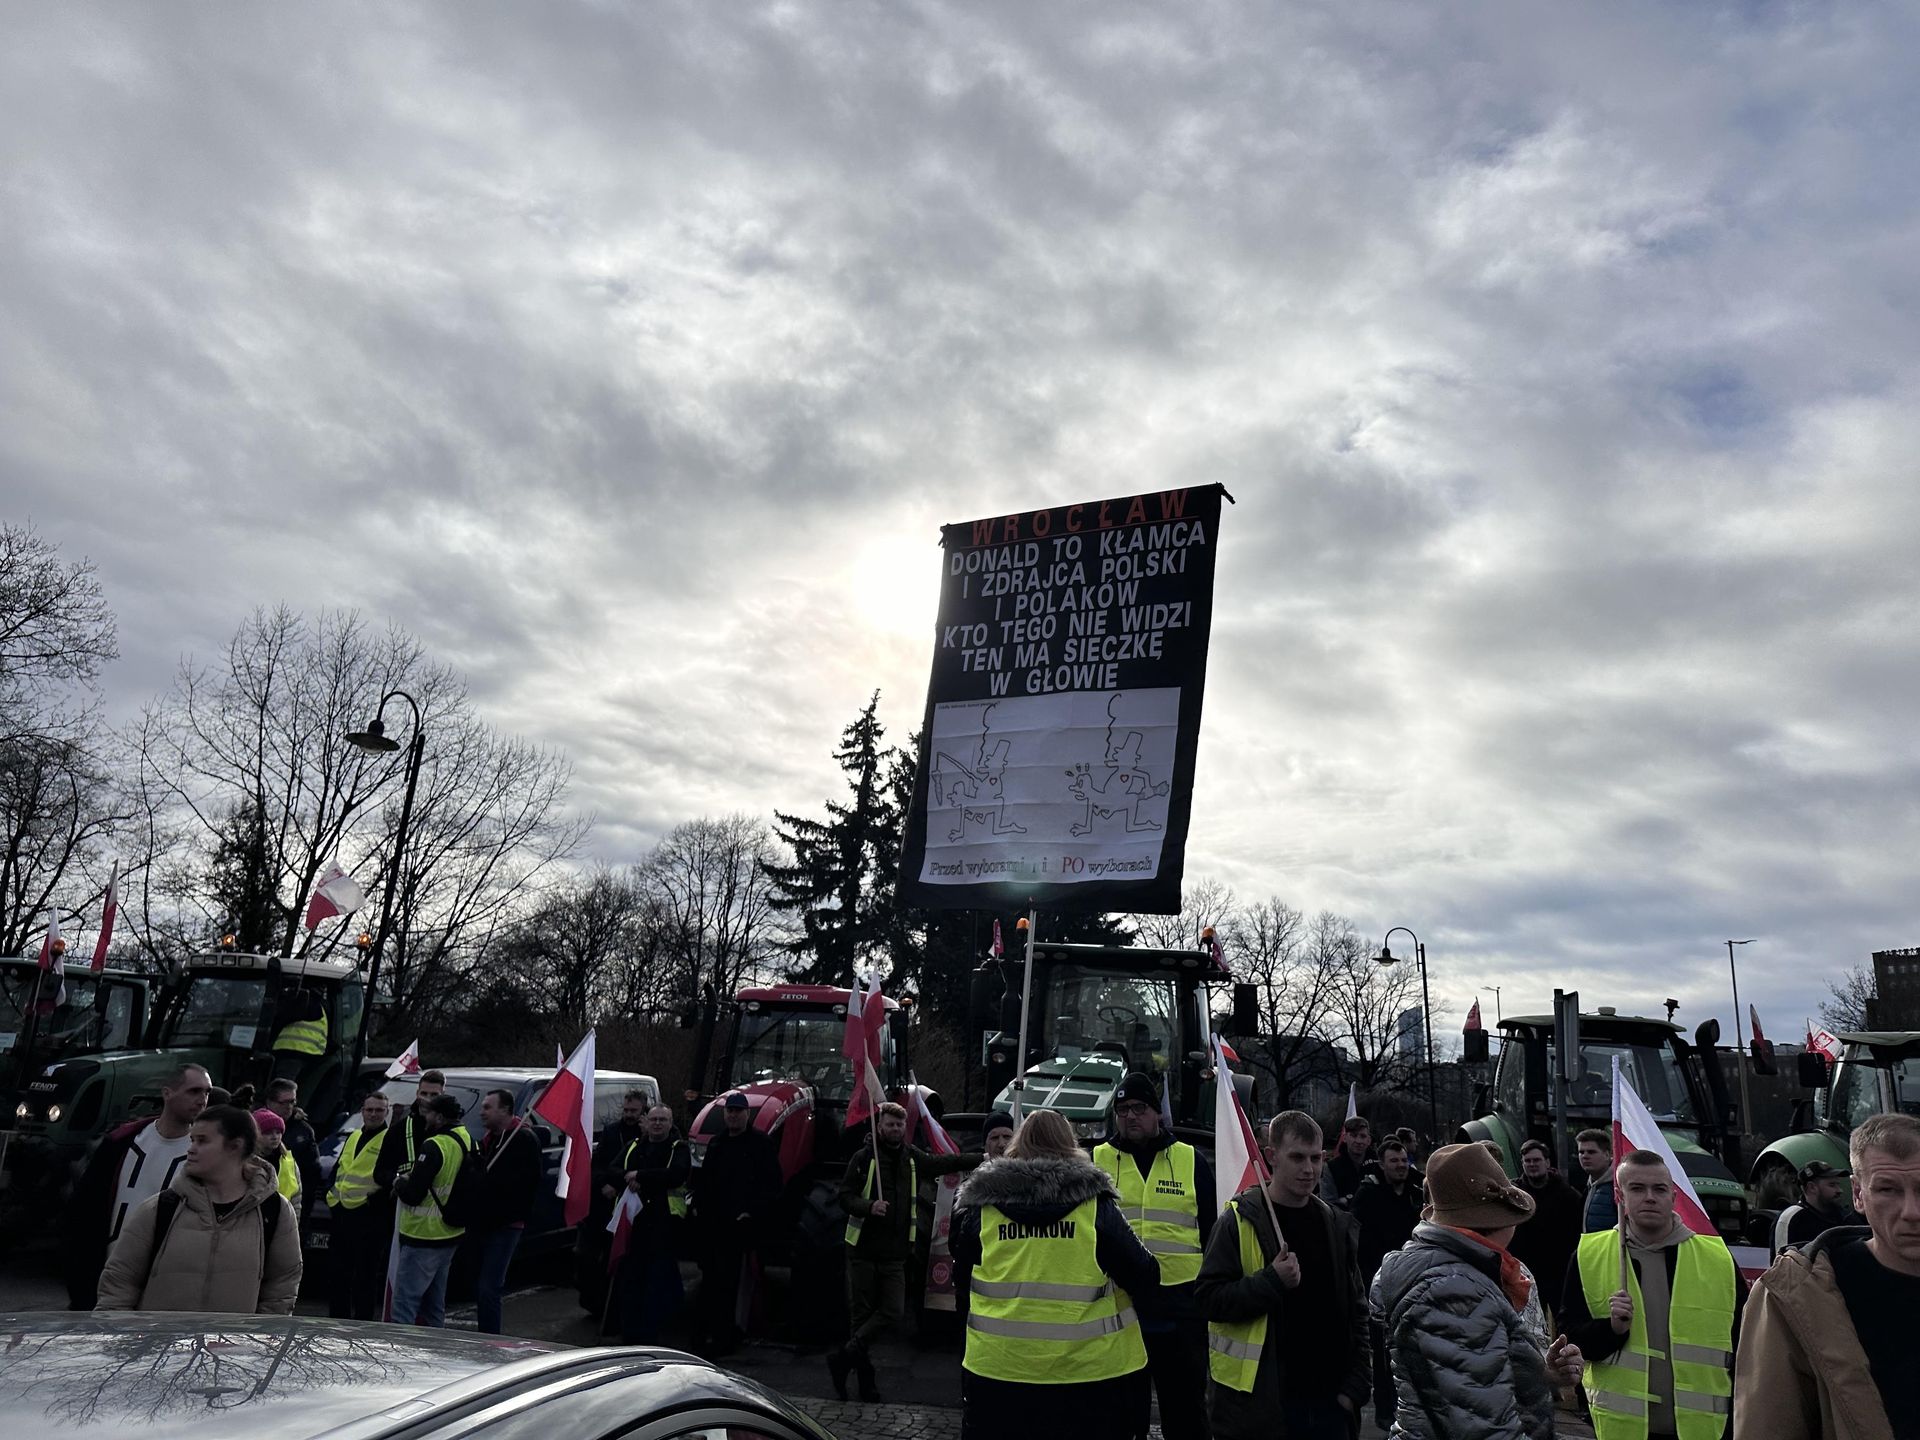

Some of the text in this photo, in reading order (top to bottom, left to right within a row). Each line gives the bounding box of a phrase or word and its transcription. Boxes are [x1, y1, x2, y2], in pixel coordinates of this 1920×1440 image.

[972, 489, 1190, 546] WROCŁAW
[951, 520, 1206, 577] DONALD TO KŁAMCA
[963, 548, 1187, 599] I ZDRAJCA POLSKI
[995, 579, 1140, 621] I POLAKÓW
[942, 600, 1192, 649] KTO TEGO NIE WIDZI
[961, 631, 1163, 672] TEN MA SIECZKĘ
[990, 662, 1119, 697] W GŁOWIE
[929, 860, 963, 876] Przed
[966, 857, 1025, 878] wyborami
[1062, 856, 1085, 873] PO
[1088, 856, 1153, 877] wyborach
[28, 1081, 59, 1092] FENDT
[1155, 1187, 1185, 1196] ROLNIKÓW
[1158, 1179, 1182, 1188] PROTEST
